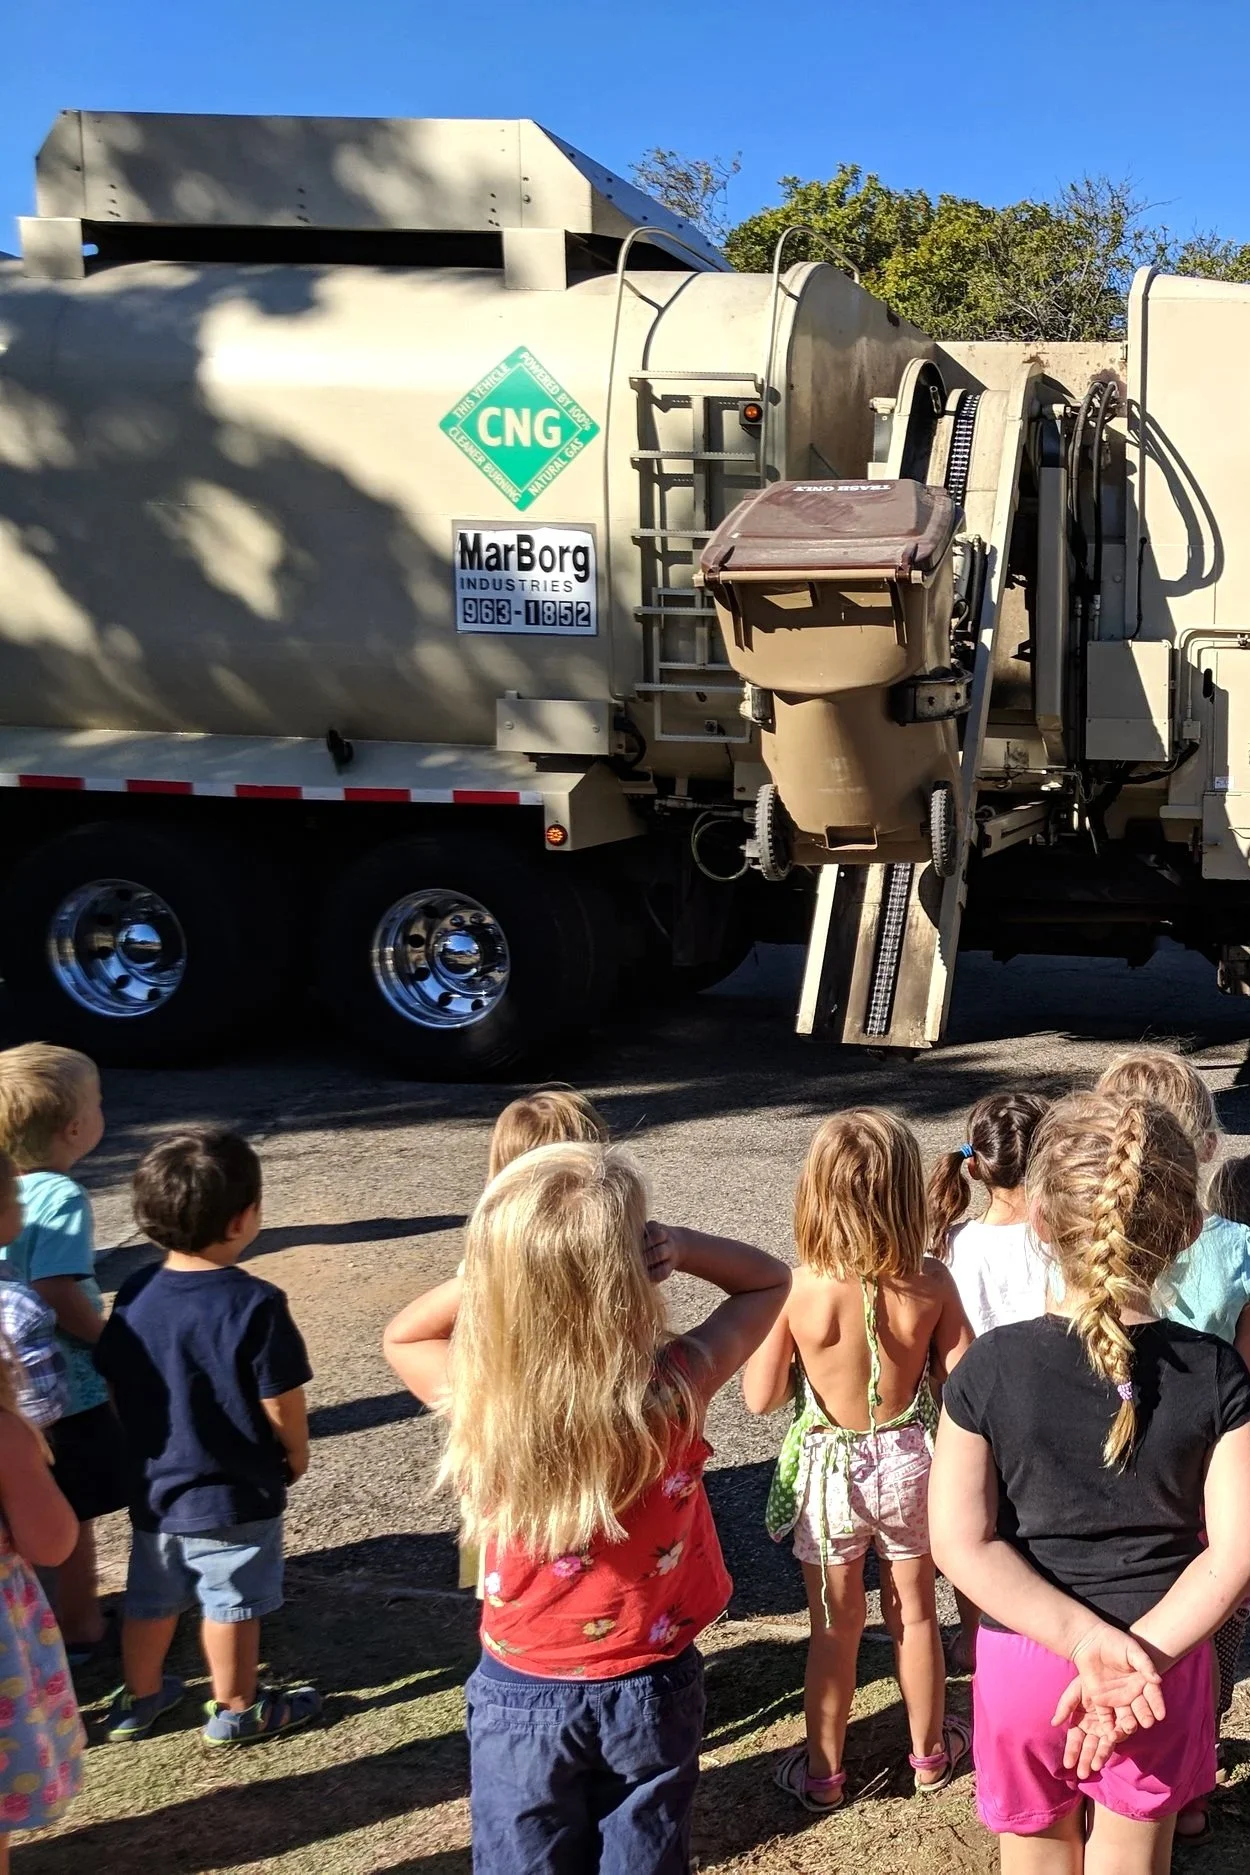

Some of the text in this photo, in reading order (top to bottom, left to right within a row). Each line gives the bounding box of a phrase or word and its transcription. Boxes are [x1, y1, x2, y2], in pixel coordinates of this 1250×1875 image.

[452, 361, 511, 419] THIS VEHICLE
[518, 350, 593, 431] POWERED BY 100%
[476, 406, 562, 449] CNG
[446, 425, 522, 503] CLEANER BURNING
[527, 437, 584, 497] NATURAL GAS
[459, 532, 590, 583] MarBorg
[460, 577, 573, 593] INDUSTRIES
[463, 598, 592, 627] 963-1852
